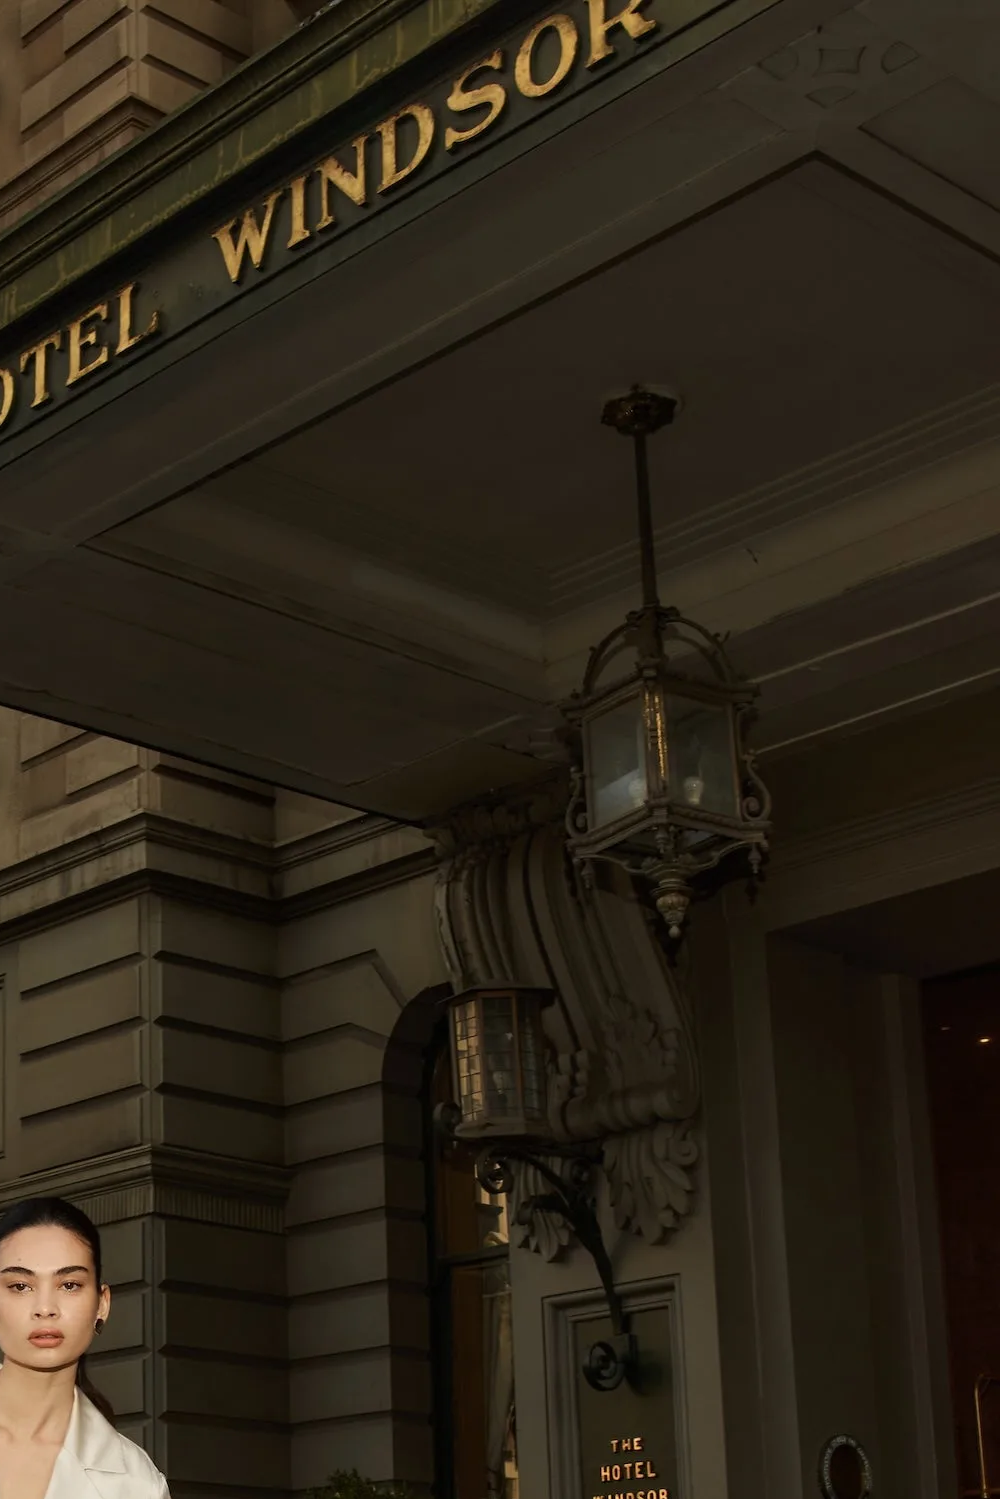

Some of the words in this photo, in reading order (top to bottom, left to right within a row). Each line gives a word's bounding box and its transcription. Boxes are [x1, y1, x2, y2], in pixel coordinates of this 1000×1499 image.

[210, 0, 657, 283] WINDSOR
[610, 1437, 643, 1453] THE
[600, 1461, 657, 1482] HOTEL
